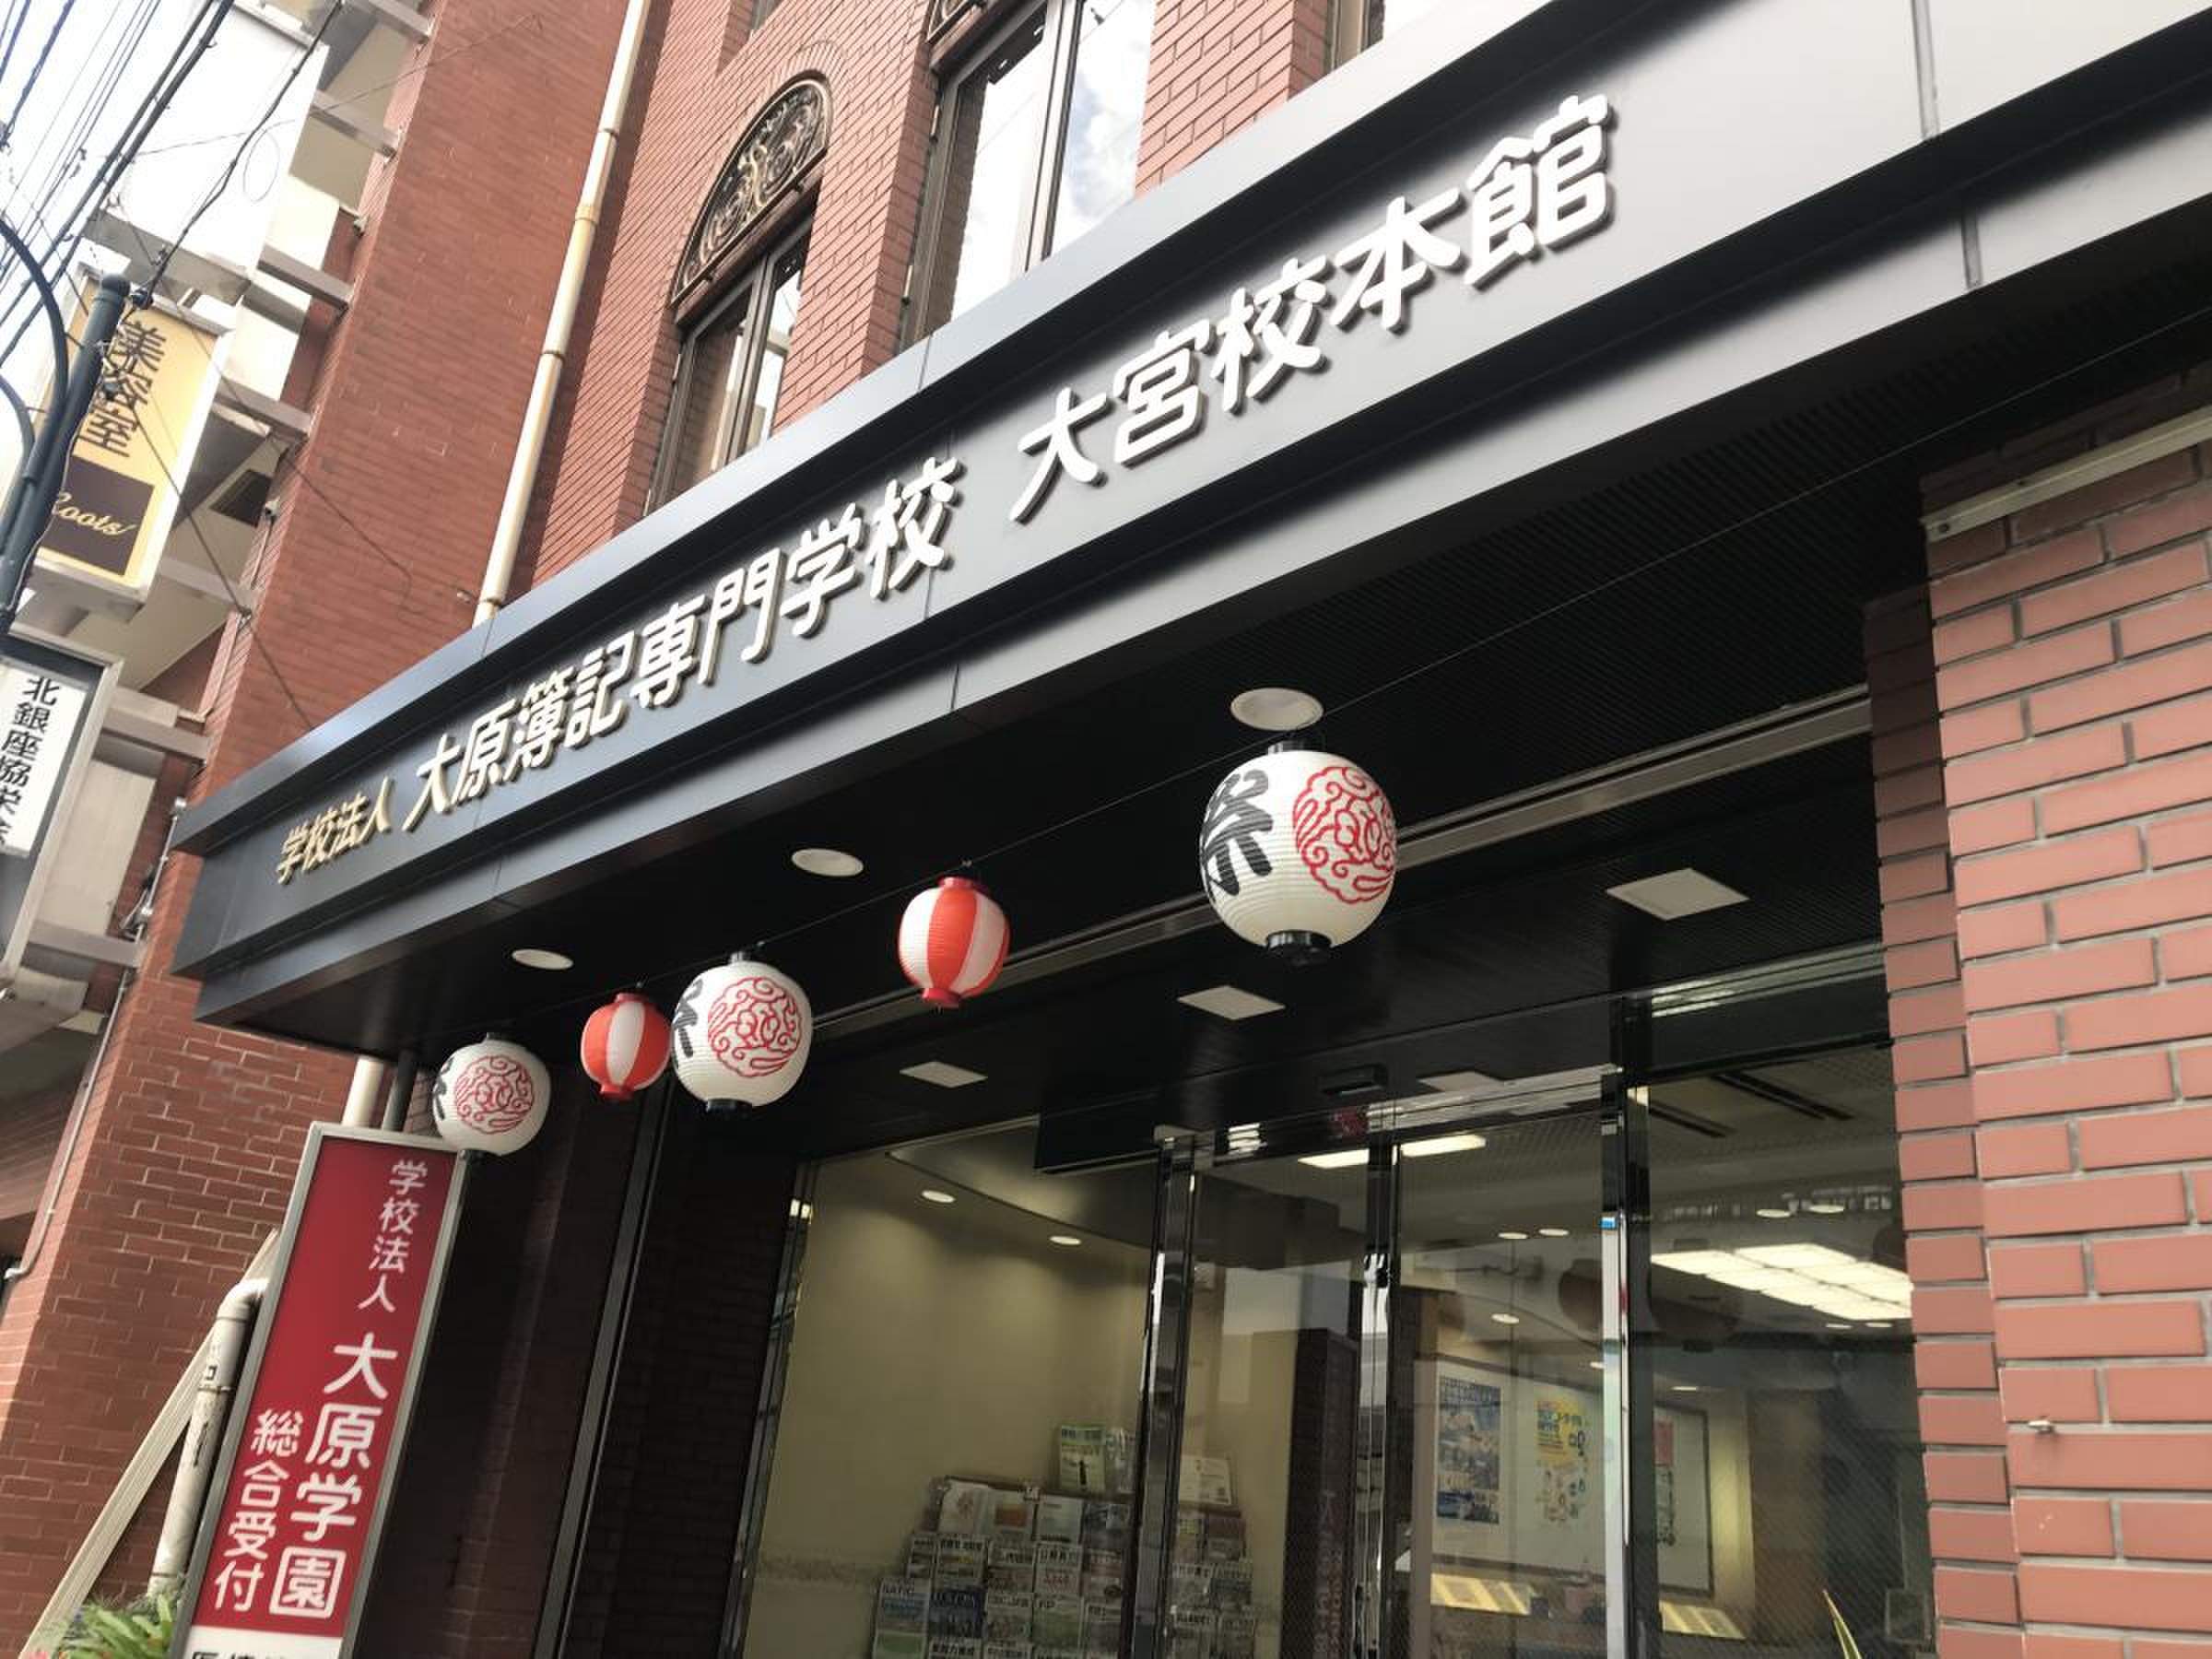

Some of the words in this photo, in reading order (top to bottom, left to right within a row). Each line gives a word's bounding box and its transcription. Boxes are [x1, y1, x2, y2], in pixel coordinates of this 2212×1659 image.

[277, 779, 392, 885] 学校法人
[402, 456, 961, 831] 大原簿記専門学校
[1009, 94, 1611, 523] 大宮校本館
[357, 1159, 428, 1313] 学校法人
[213, 1408, 304, 1613] 総合受付
[269, 1333, 397, 1618] 大原学園
